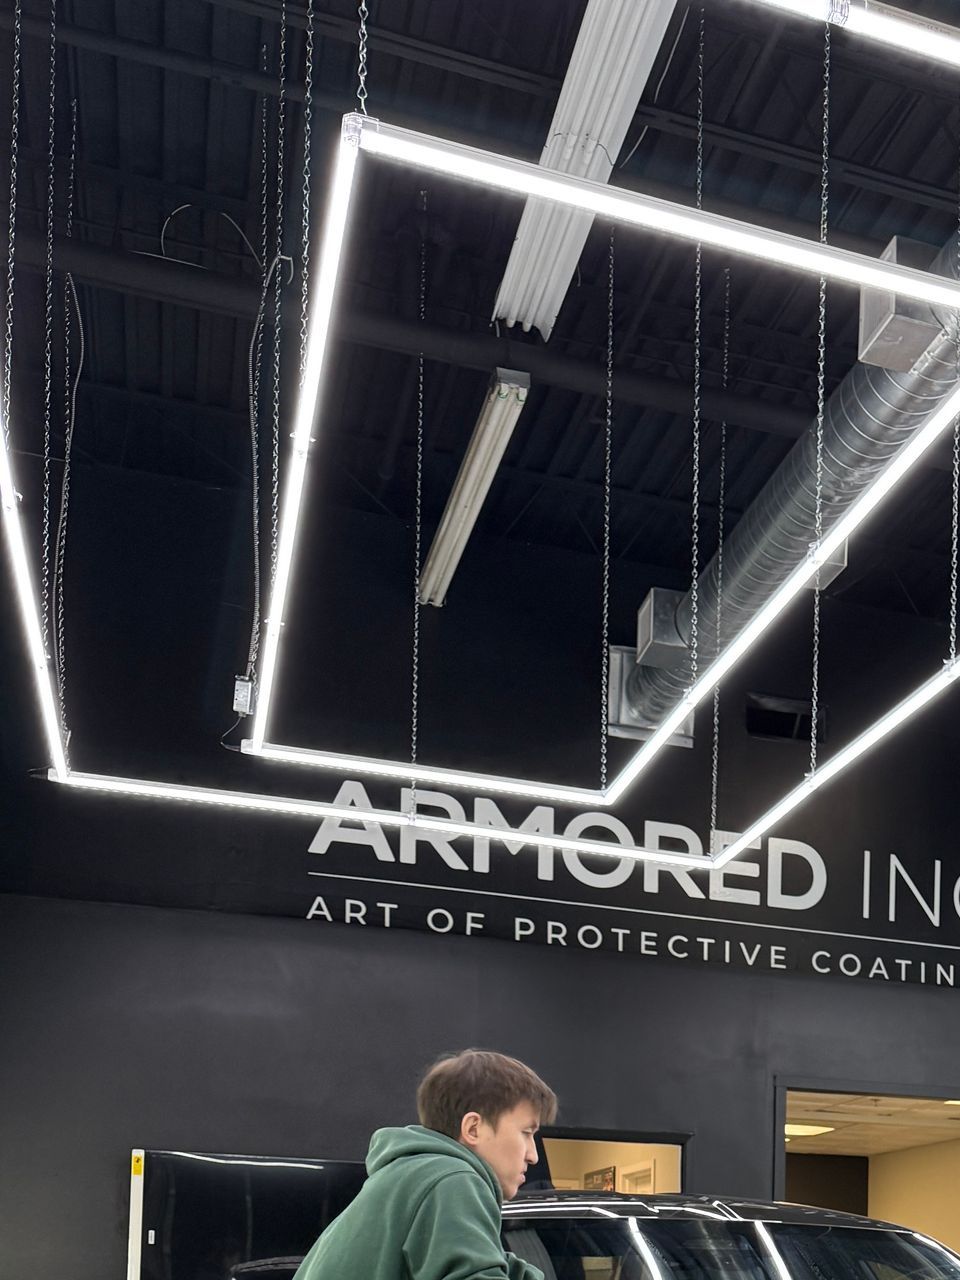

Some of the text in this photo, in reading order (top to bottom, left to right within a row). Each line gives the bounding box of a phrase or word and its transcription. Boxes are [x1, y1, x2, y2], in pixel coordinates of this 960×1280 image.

[307, 779, 828, 911] ARMORED
[305, 896, 399, 928] ART
[426, 907, 486, 936] OF
[513, 916, 788, 970] PROTECTIVE
